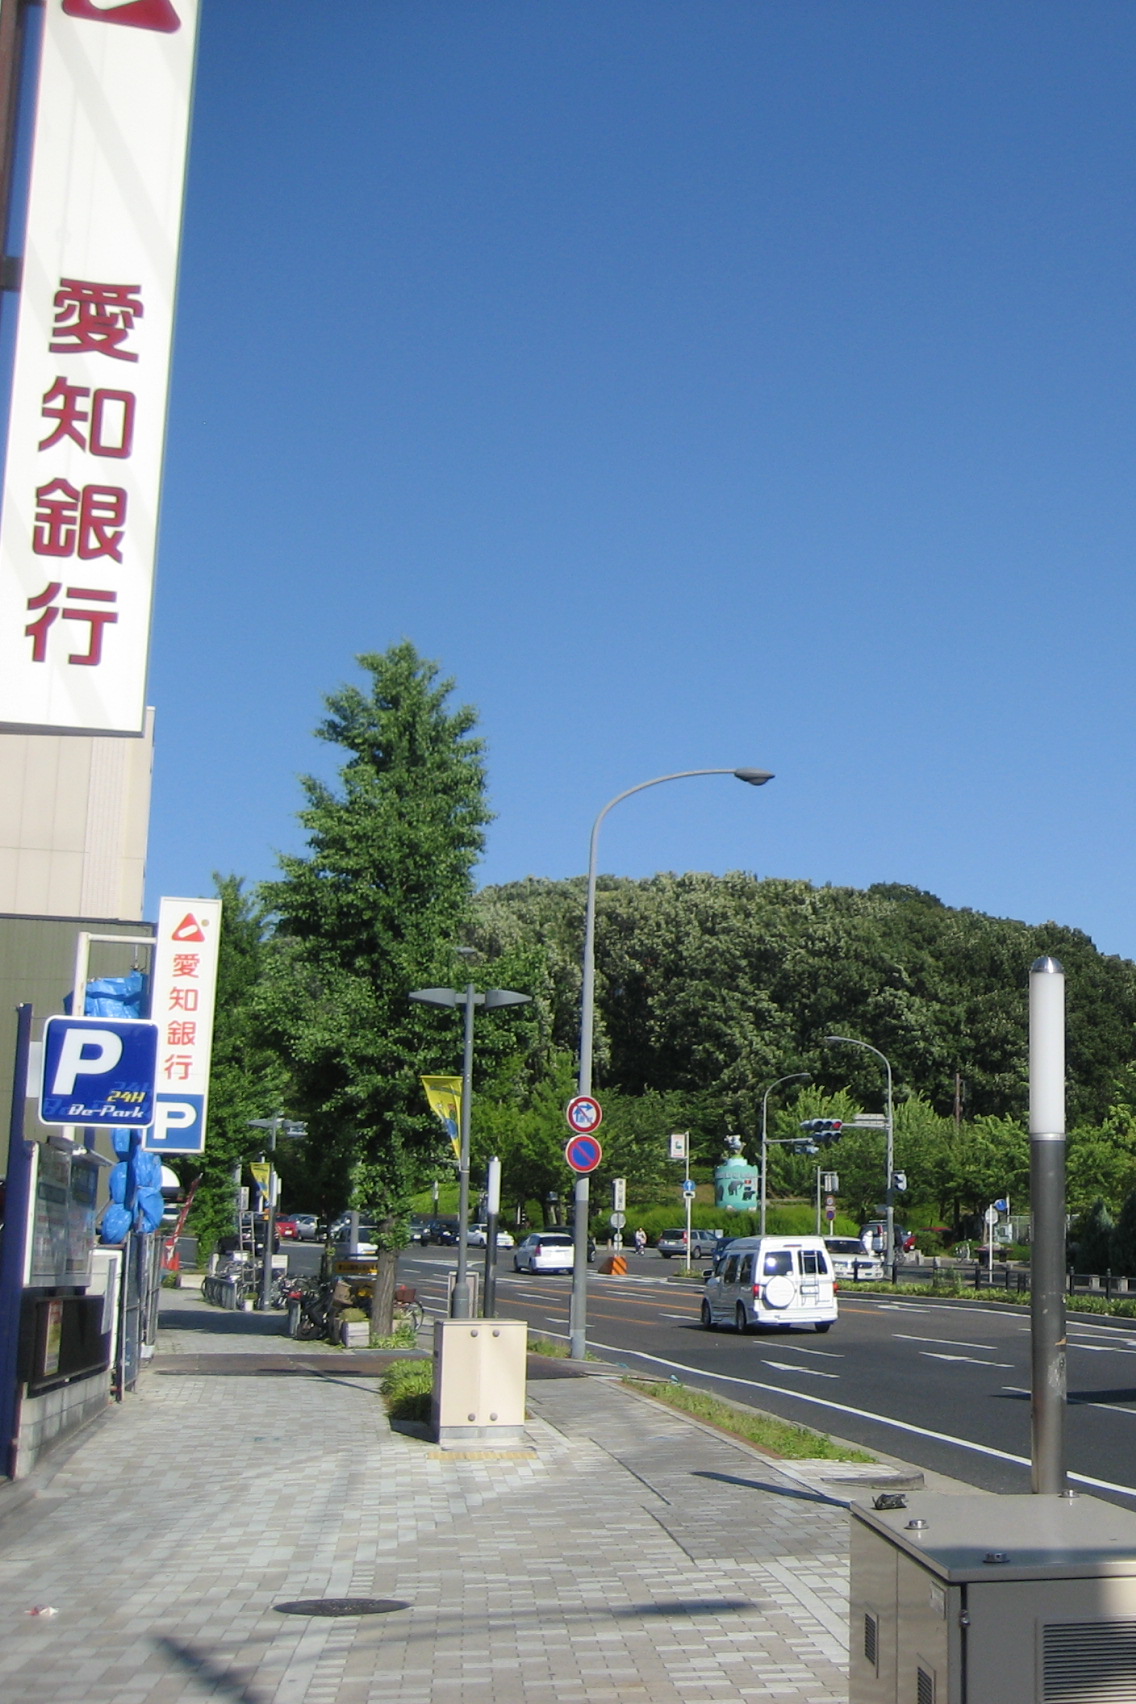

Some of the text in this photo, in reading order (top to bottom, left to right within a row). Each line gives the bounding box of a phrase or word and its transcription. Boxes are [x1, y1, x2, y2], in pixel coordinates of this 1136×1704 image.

[24, 277, 143, 666] 愛知銀行
[164, 952, 201, 1081] 愛知銀行
[52, 1028, 123, 1095] P
[68, 1103, 144, 1118] Be-Park
[107, 1090, 146, 1103] 24H
[153, 1102, 197, 1140] P
